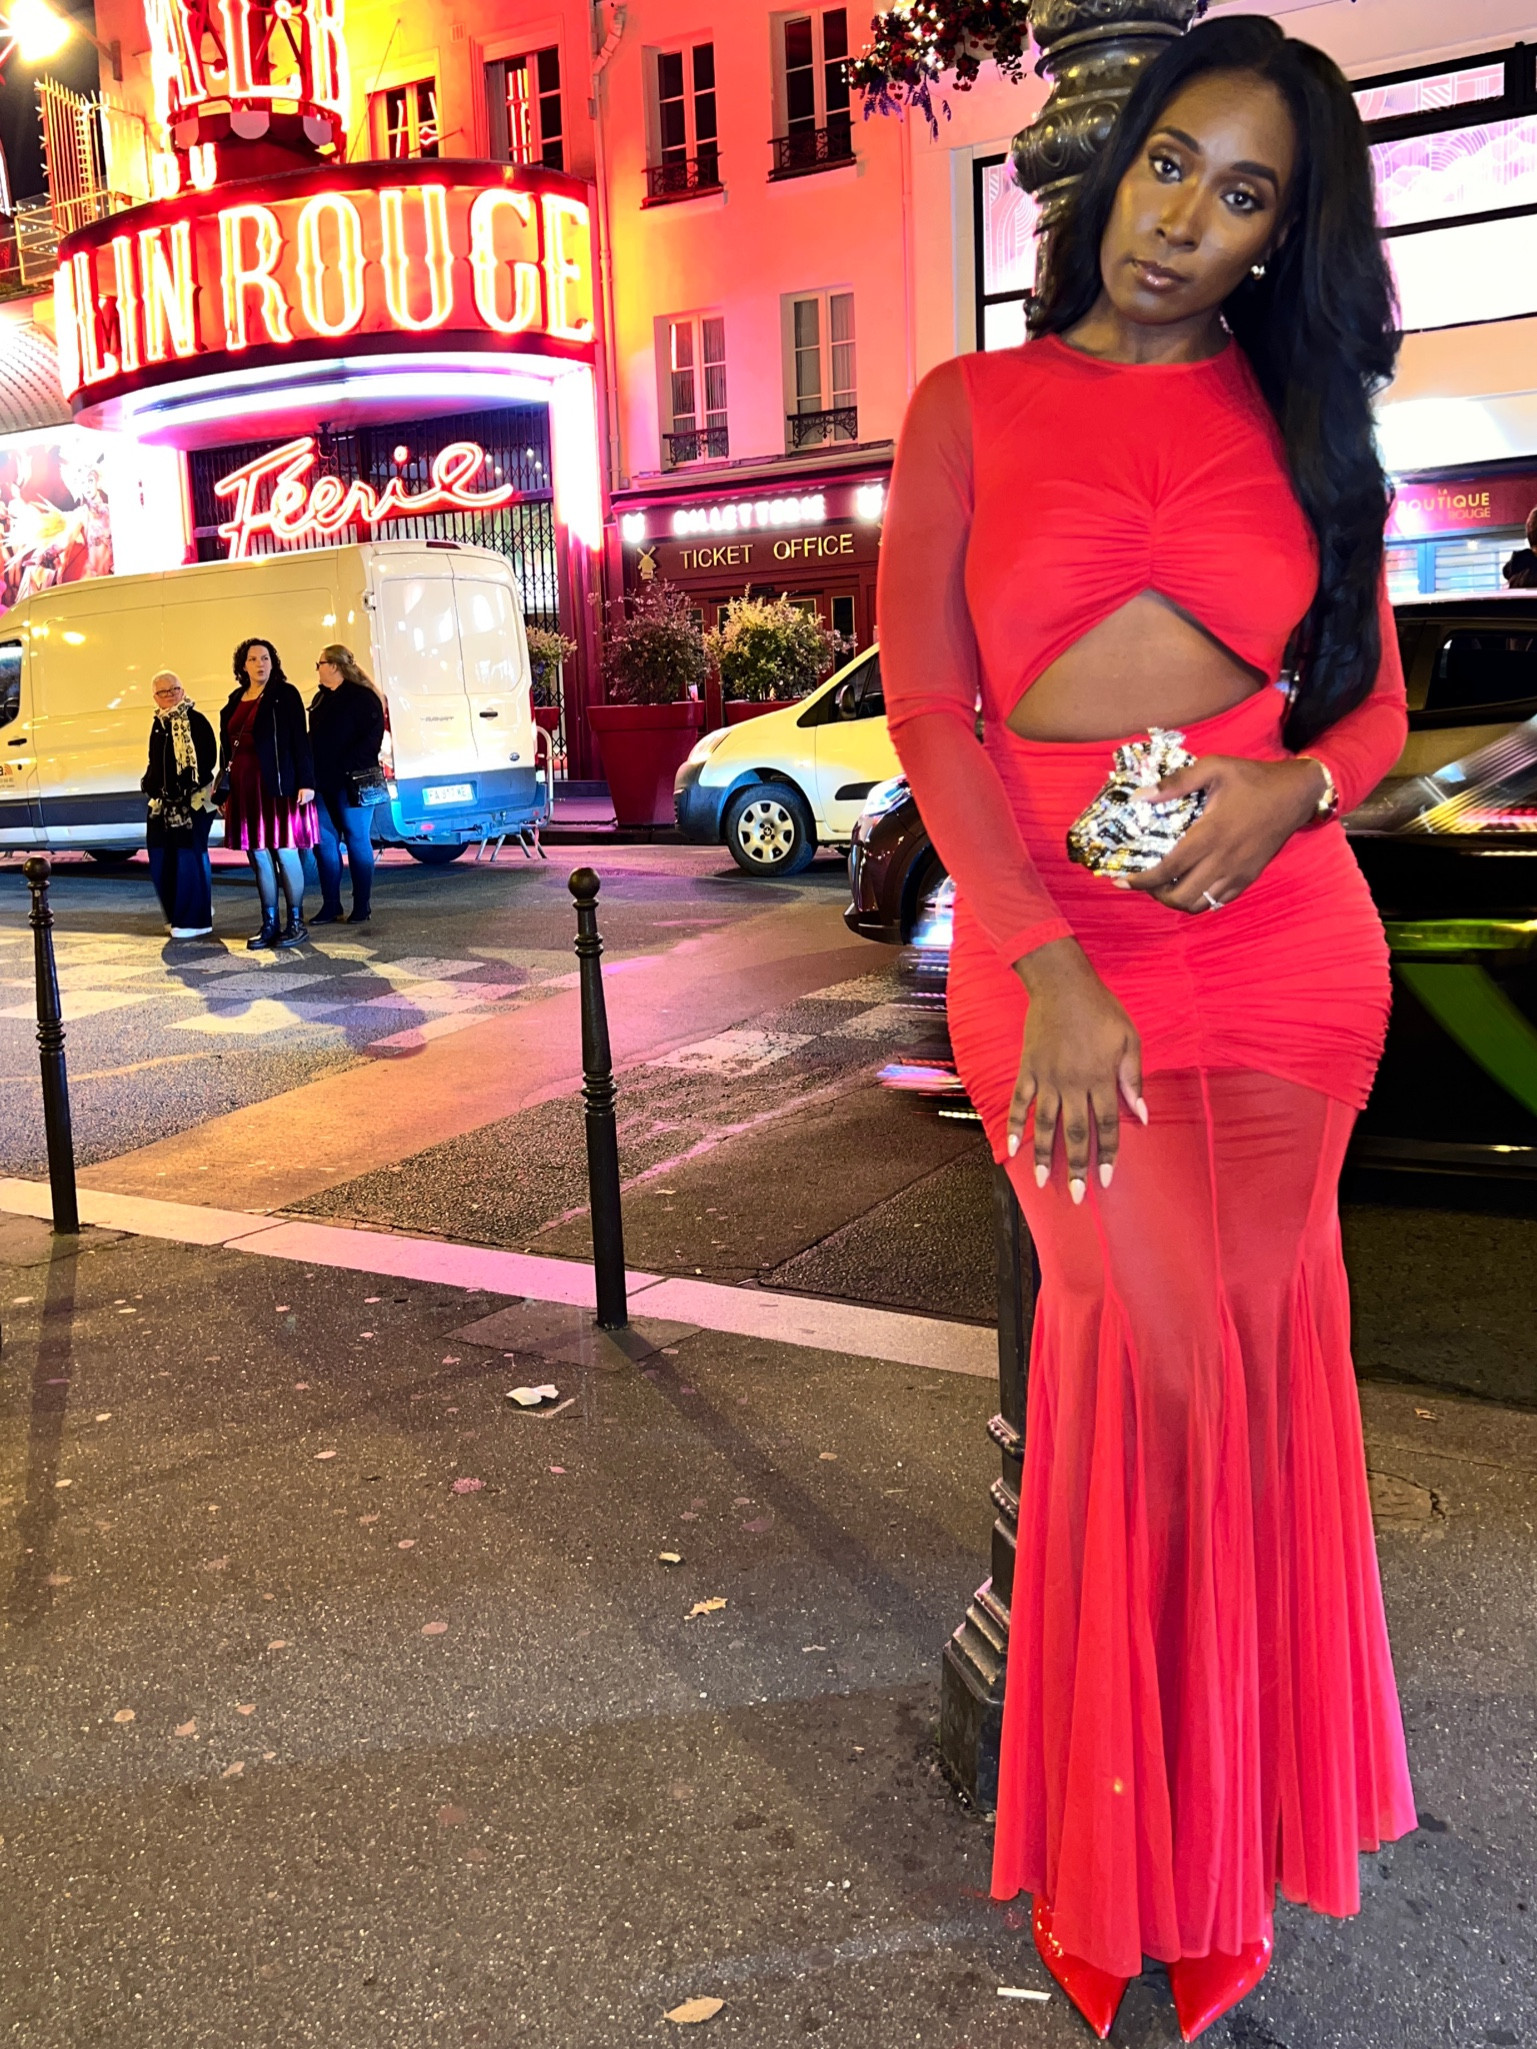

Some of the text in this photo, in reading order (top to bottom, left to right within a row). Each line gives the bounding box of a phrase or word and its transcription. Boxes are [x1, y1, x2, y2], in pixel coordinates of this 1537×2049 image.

[217, 183, 596, 352] ROUGE
[679, 533, 854, 570] TICKET OFFICE
